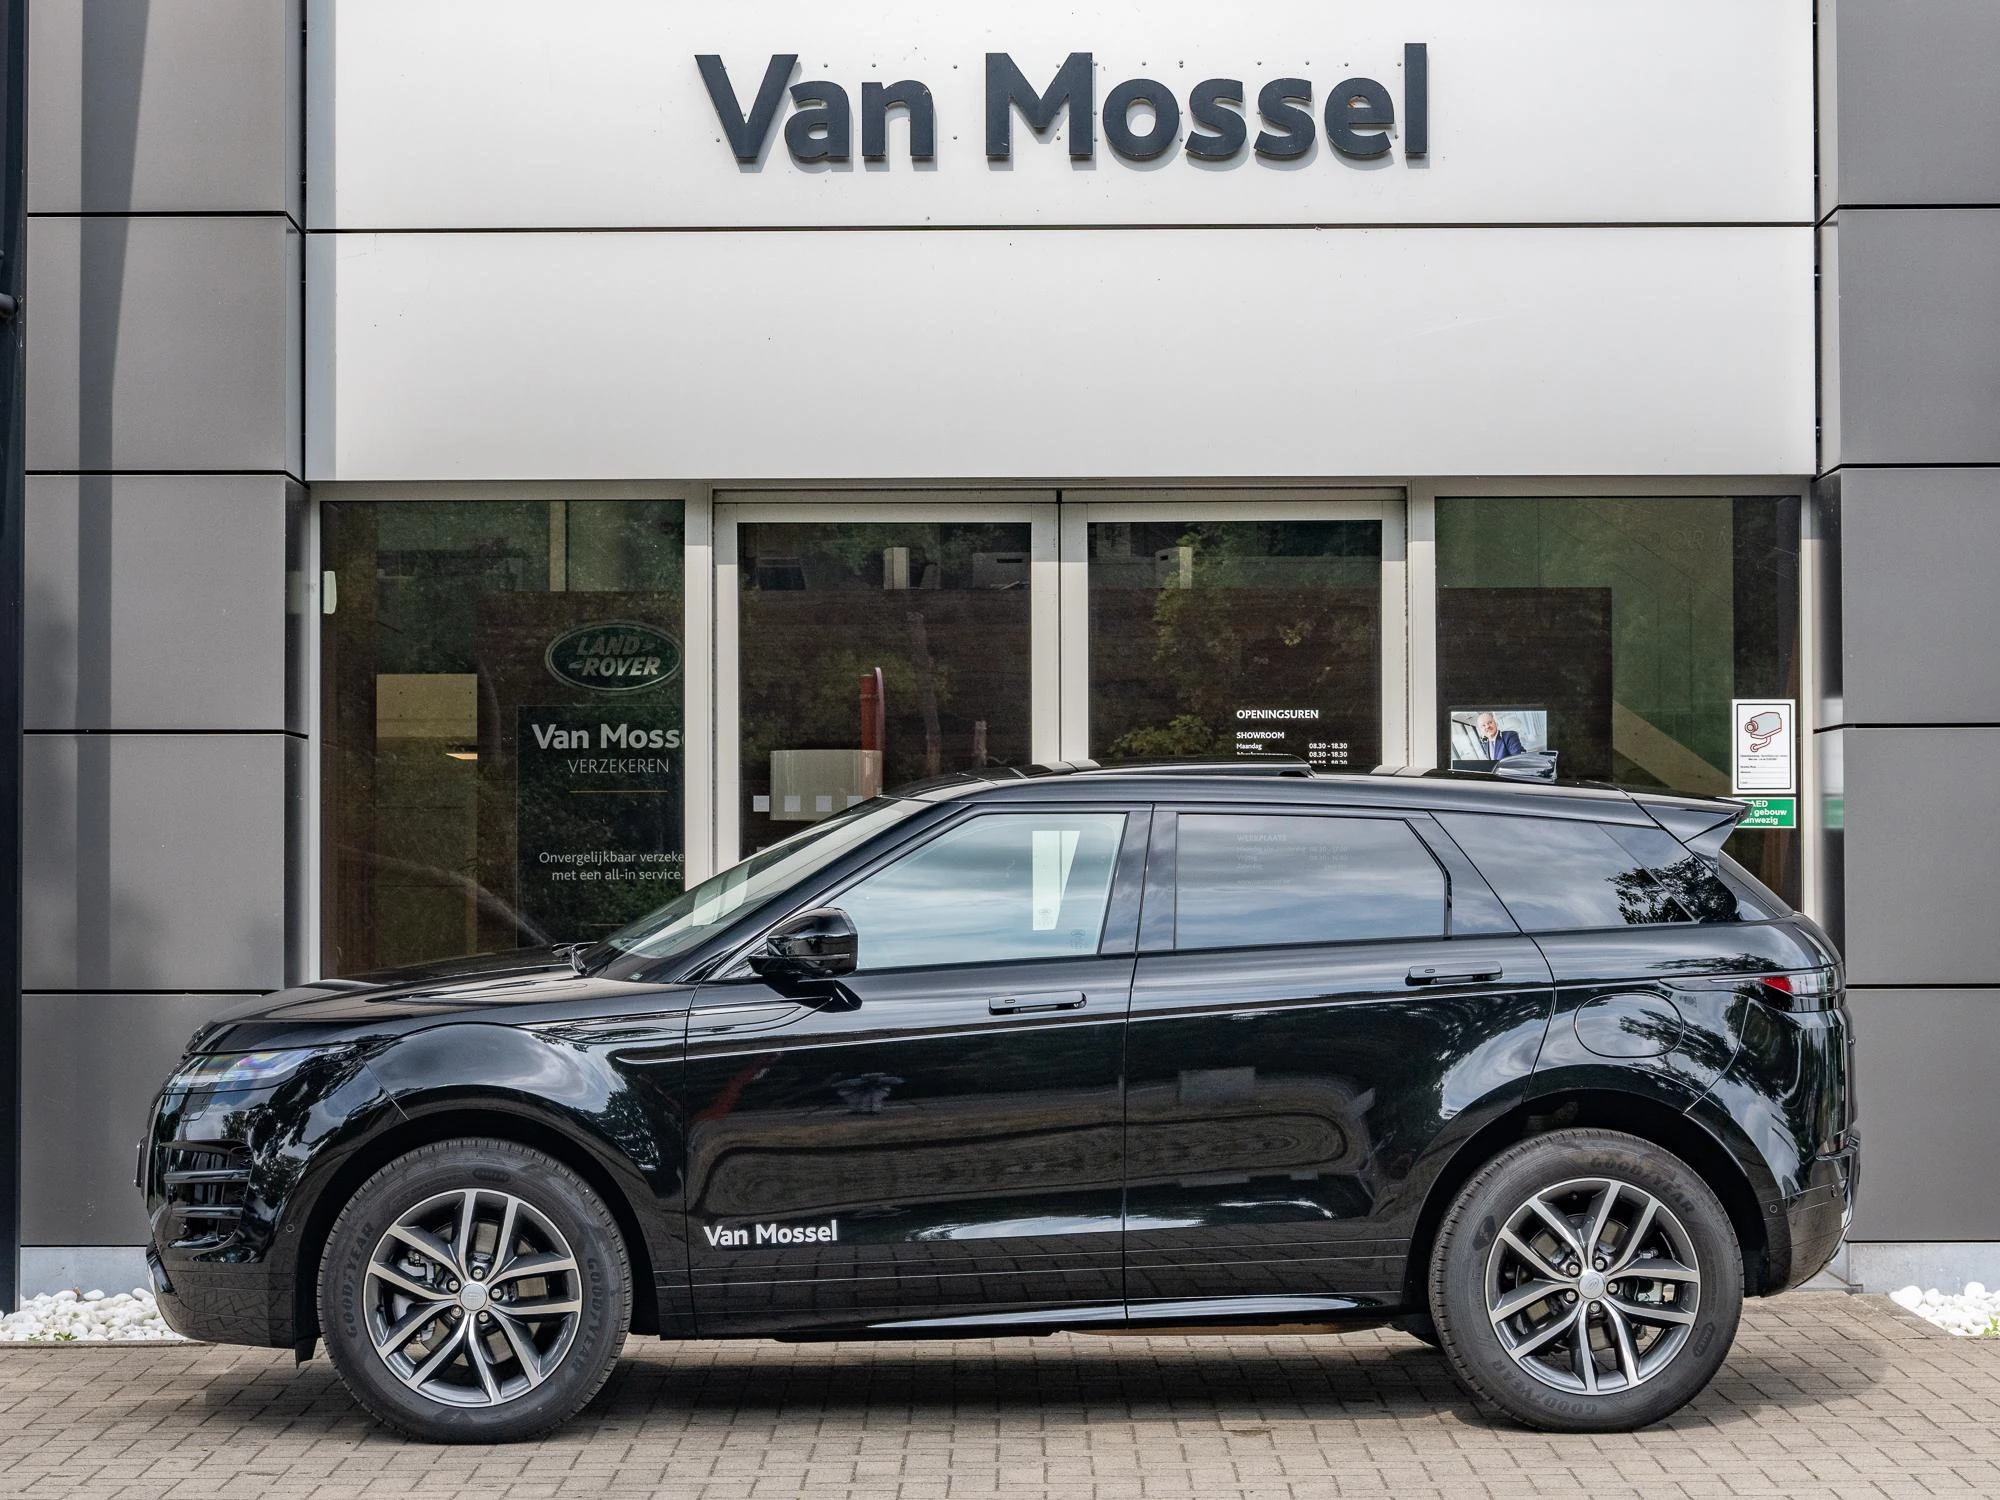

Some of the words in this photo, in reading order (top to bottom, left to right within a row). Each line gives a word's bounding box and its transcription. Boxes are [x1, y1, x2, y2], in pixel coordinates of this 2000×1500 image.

[695, 54, 934, 160] Van
[985, 43, 1428, 160] Mossel
[576, 634, 641, 656] LAND
[582, 656, 661, 677] ROVER
[1236, 709, 1319, 719] OPENINGSUREN
[531, 723, 590, 750] Van
[600, 723, 685, 749] Moss
[567, 758, 669, 774] VERZEKEREN
[1754, 808, 1787, 817] gebouw
[539, 851, 636, 865] Onvergelijkbaar
[551, 869, 577, 880] met
[579, 870, 602, 880] een
[604, 867, 636, 880] all-in
[638, 868, 684, 880] service.
[703, 1225, 749, 1246] Van
[755, 1219, 838, 1244] Mossel
